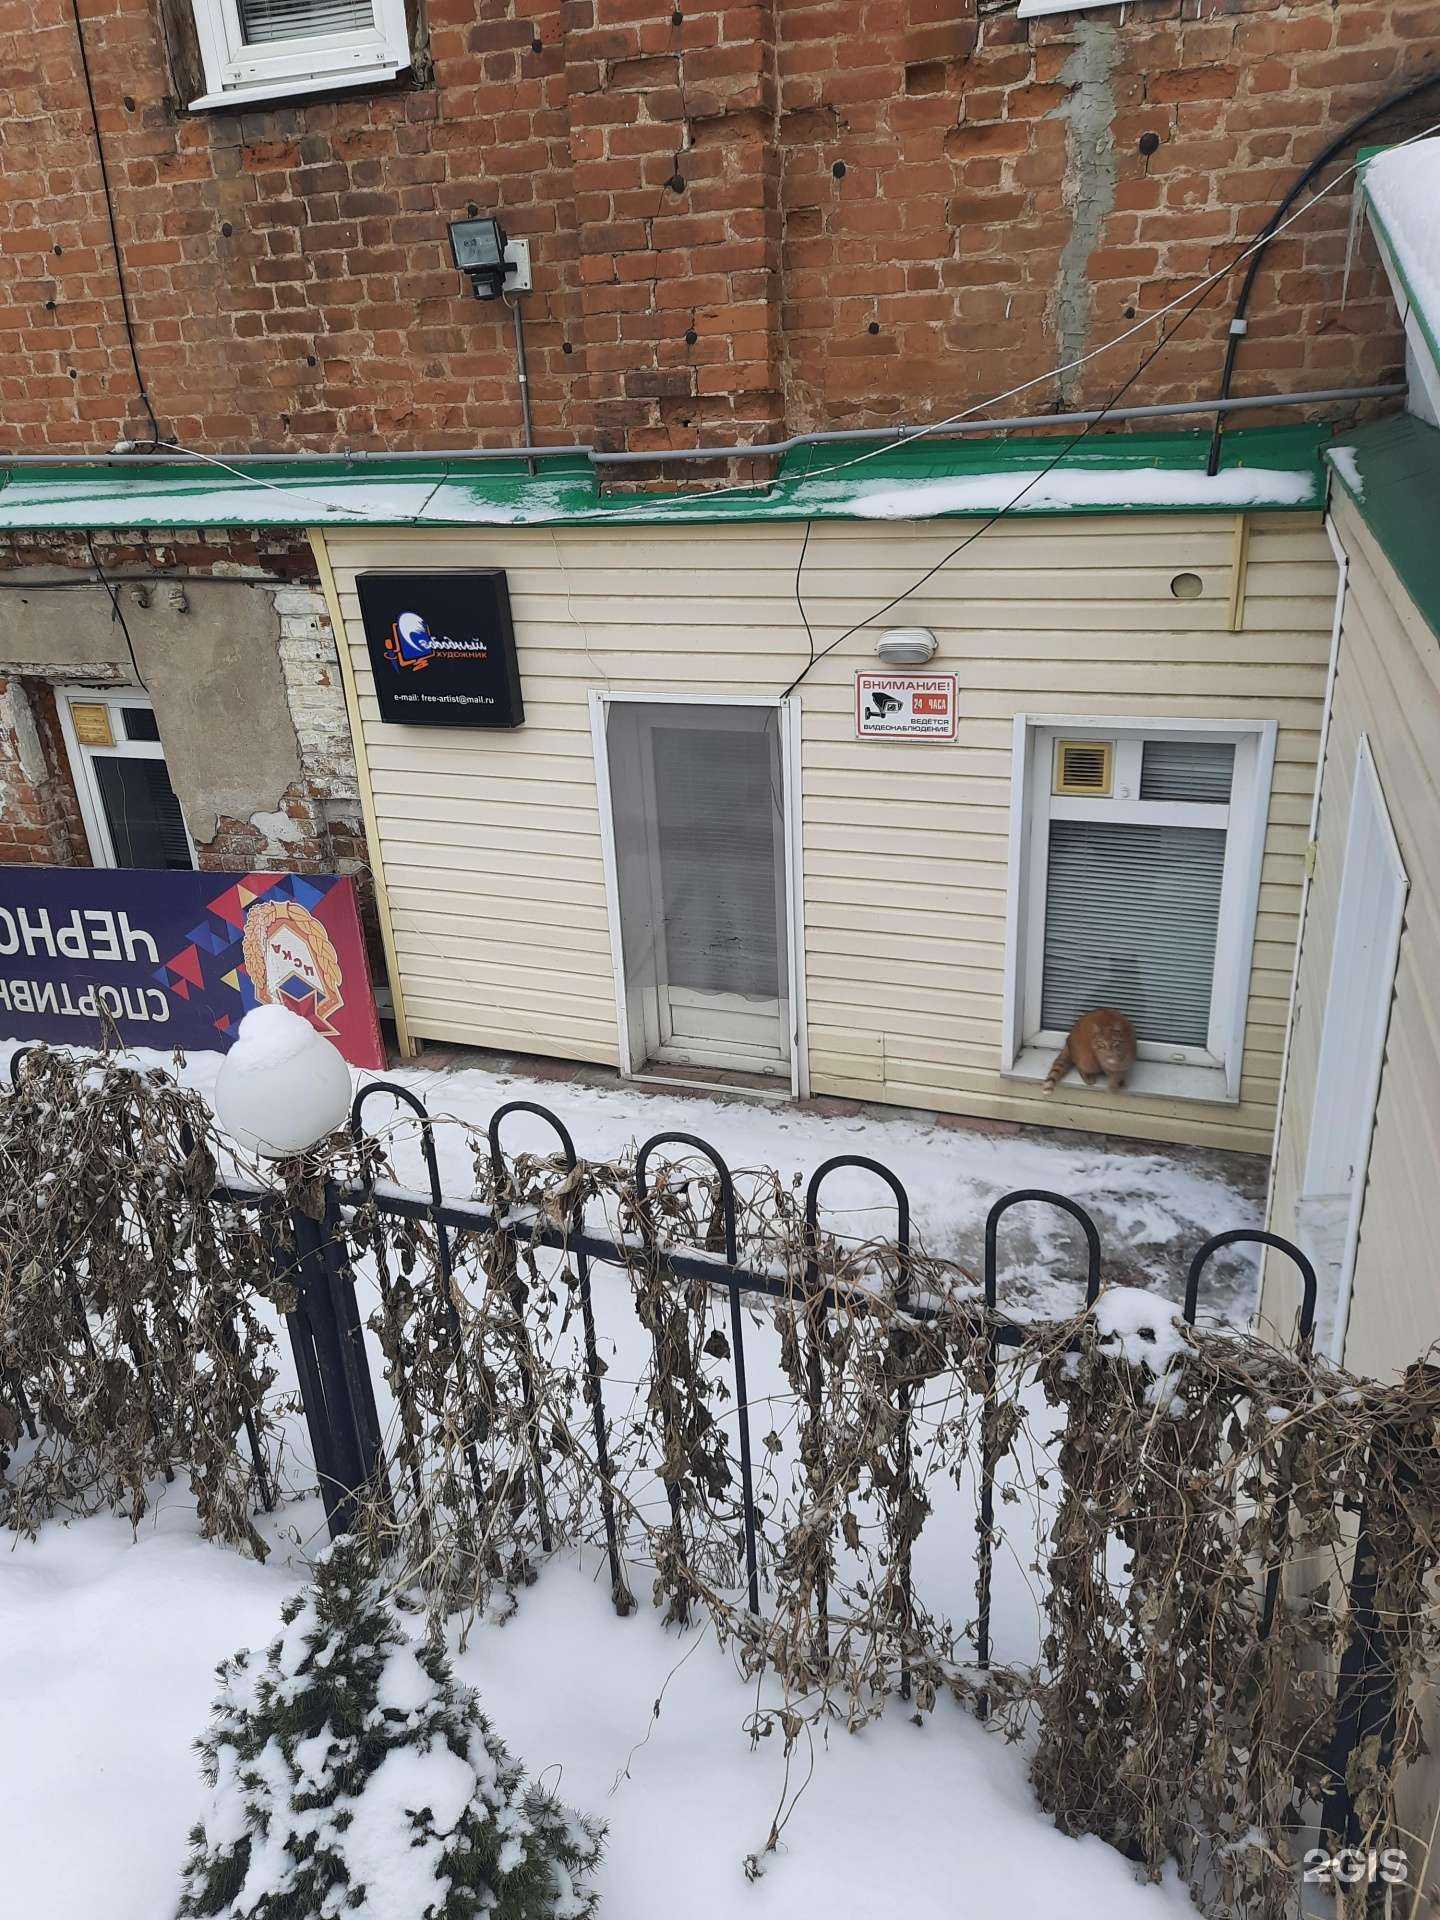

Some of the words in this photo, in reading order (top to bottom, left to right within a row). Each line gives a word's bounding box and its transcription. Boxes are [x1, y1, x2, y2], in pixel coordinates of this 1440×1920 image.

[863, 680, 950, 691] ВНИМАНИЕ!
[394, 694, 419, 702] e-mail:
[421, 694, 494, 704] free-artist@mail.ru
[914, 699, 922, 709] 24
[928, 699, 946, 709] ЧАСА
[864, 724, 949, 732] ВИДЕОНАБЛЮДЕНИЕ
[271, 944, 314, 976] ЦСКА
